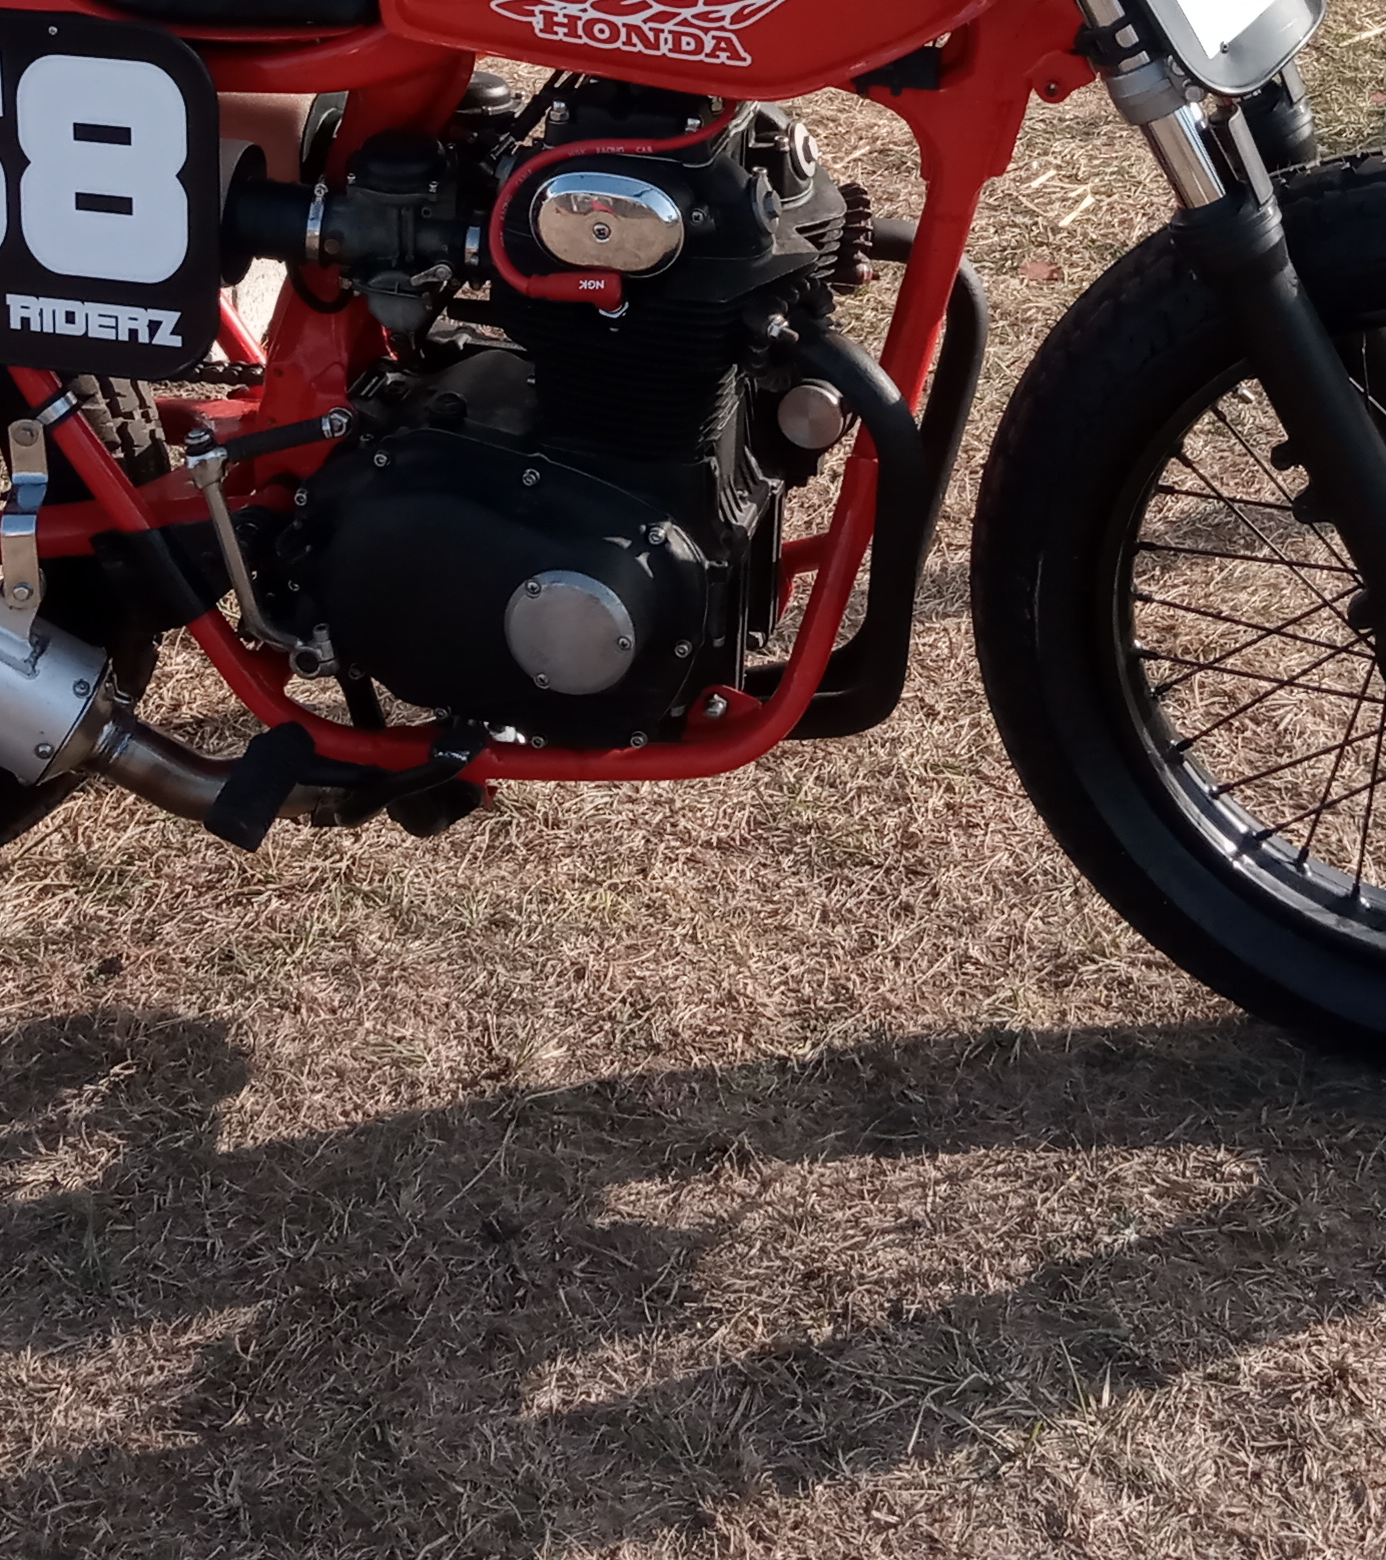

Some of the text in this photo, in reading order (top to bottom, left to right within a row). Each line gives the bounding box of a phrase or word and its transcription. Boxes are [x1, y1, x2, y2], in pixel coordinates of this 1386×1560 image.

[533, 6, 752, 66] HONDA
[578, 279, 605, 290] NGK
[6, 292, 183, 348] RIDERZ
